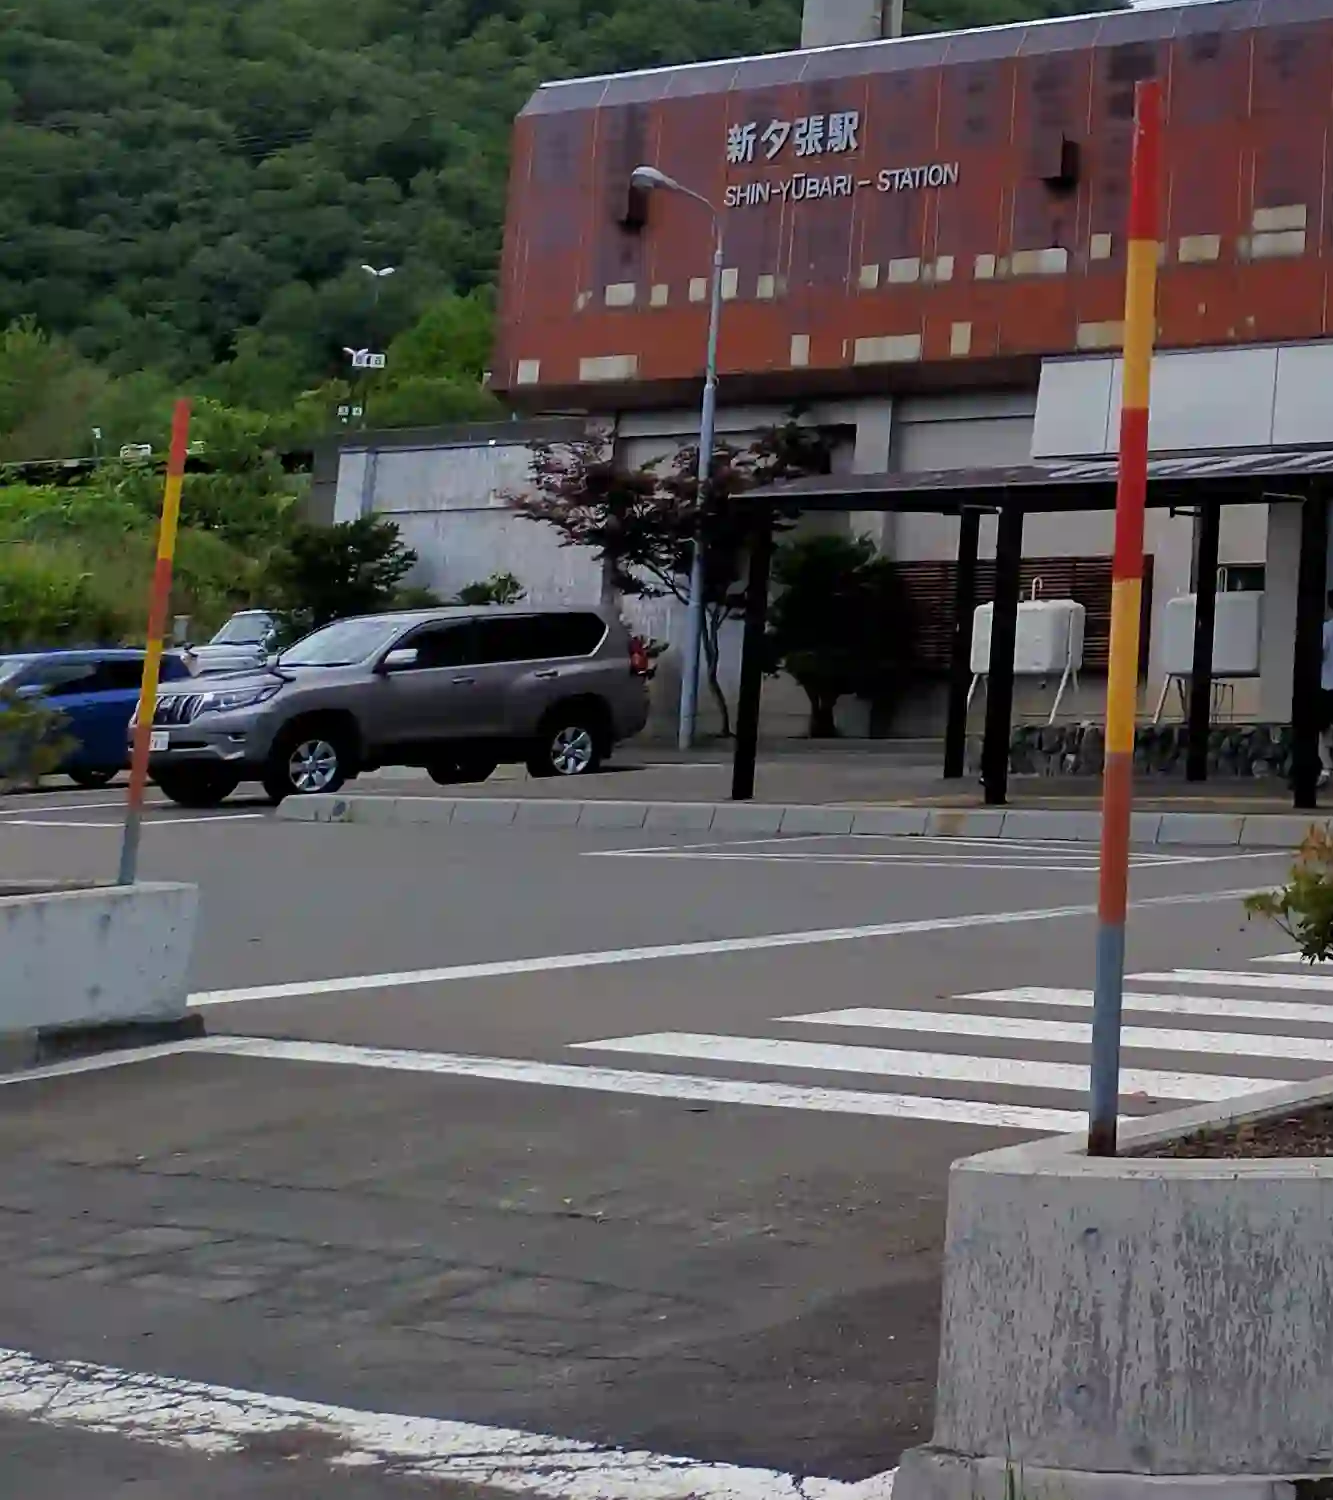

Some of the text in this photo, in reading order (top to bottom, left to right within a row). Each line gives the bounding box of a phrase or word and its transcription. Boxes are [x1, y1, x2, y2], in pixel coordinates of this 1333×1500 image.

[725, 110, 859, 164] 新夕張駅
[876, 160, 960, 192] STATION
